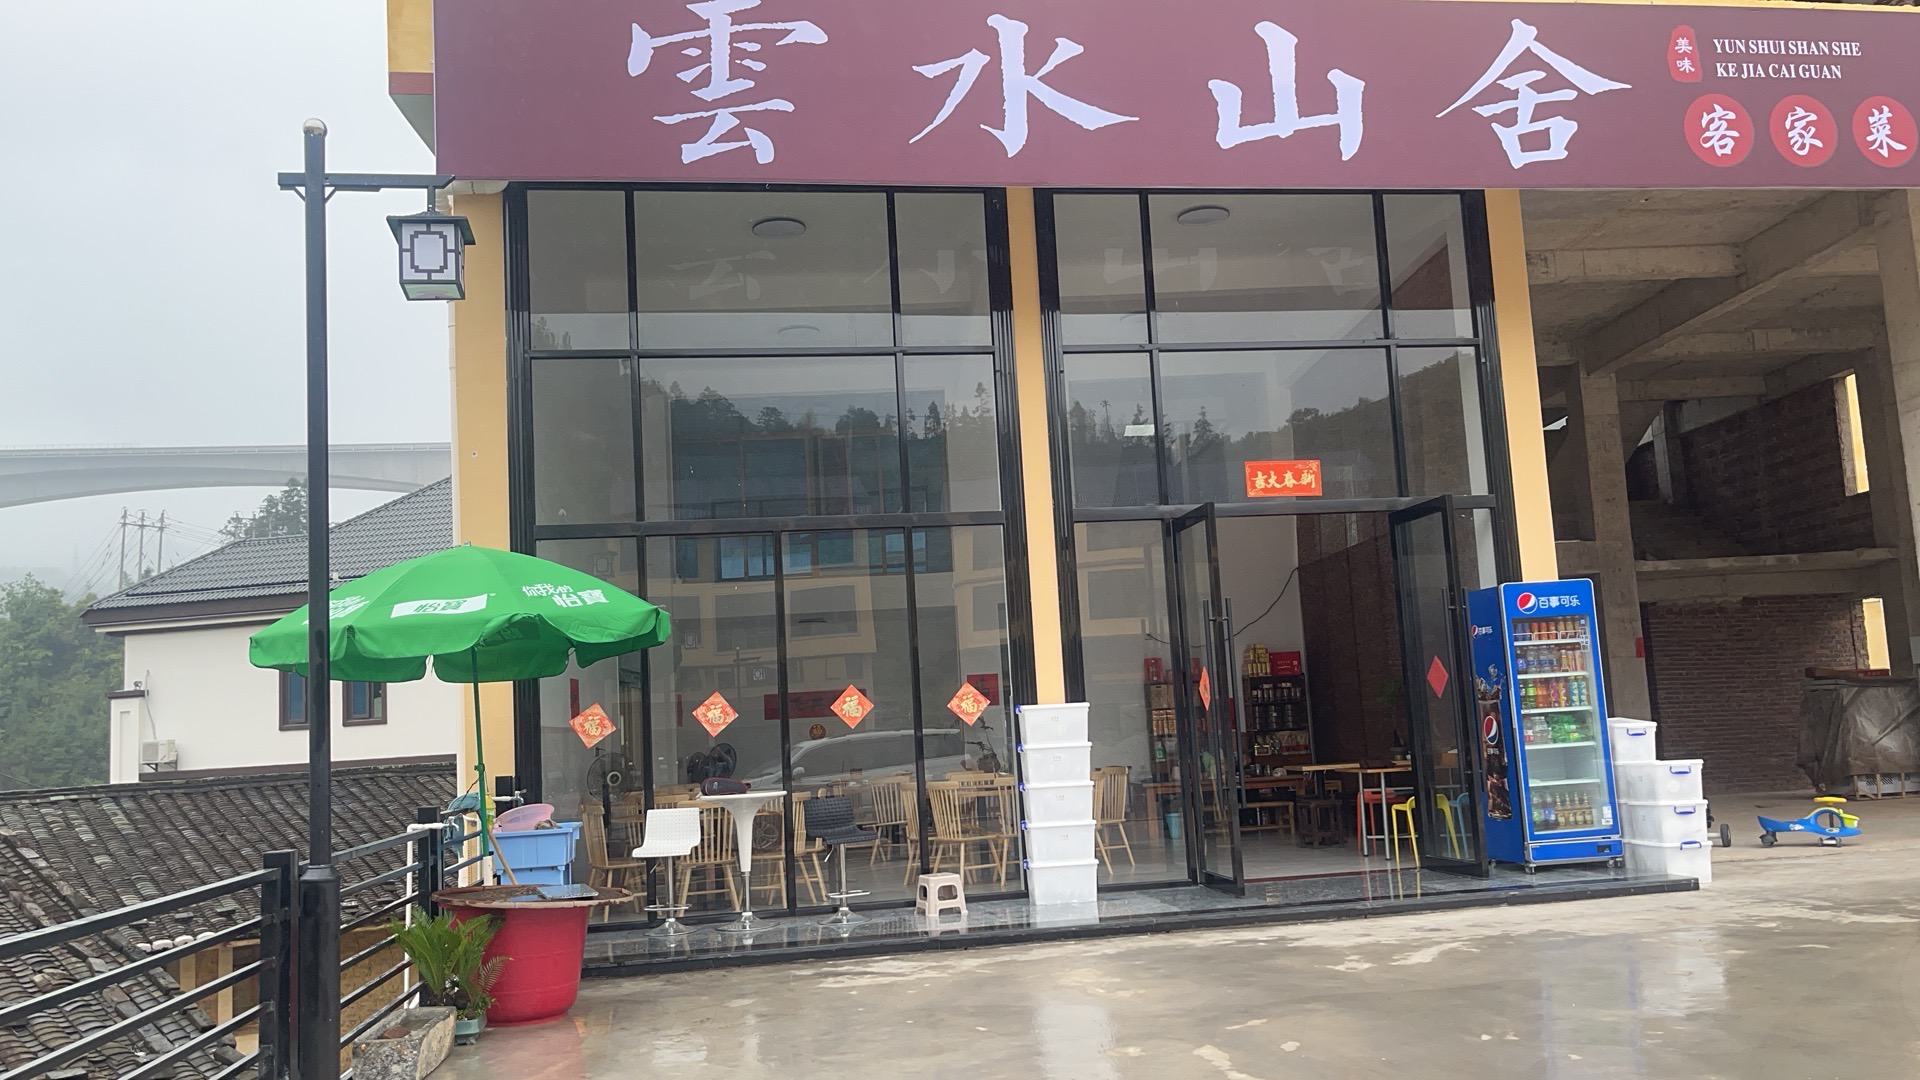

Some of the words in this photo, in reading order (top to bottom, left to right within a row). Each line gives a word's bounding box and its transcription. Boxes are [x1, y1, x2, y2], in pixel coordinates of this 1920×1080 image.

[1674, 37, 1696, 74] 美味
[1713, 39, 1746, 54] YUN
[1749, 39, 1785, 55] SHUI
[1788, 41, 1829, 56] SHAN
[1832, 41, 1862, 56] SHE
[1715, 62, 1739, 78] KE
[1741, 63, 1766, 79] JIA
[1768, 64, 1797, 79] CAI
[1798, 64, 1842, 79] GUAN
[627, 0, 1633, 170] 雲水山舍
[1700, 103, 1908, 158] 客家菜
[521, 583, 574, 597] 你我的
[1538, 594, 1581, 609] 百事可乐
[841, 694, 863, 718] 福
[960, 692, 979, 714] 福
[706, 704, 725, 725] 福
[583, 715, 601, 737] 福
